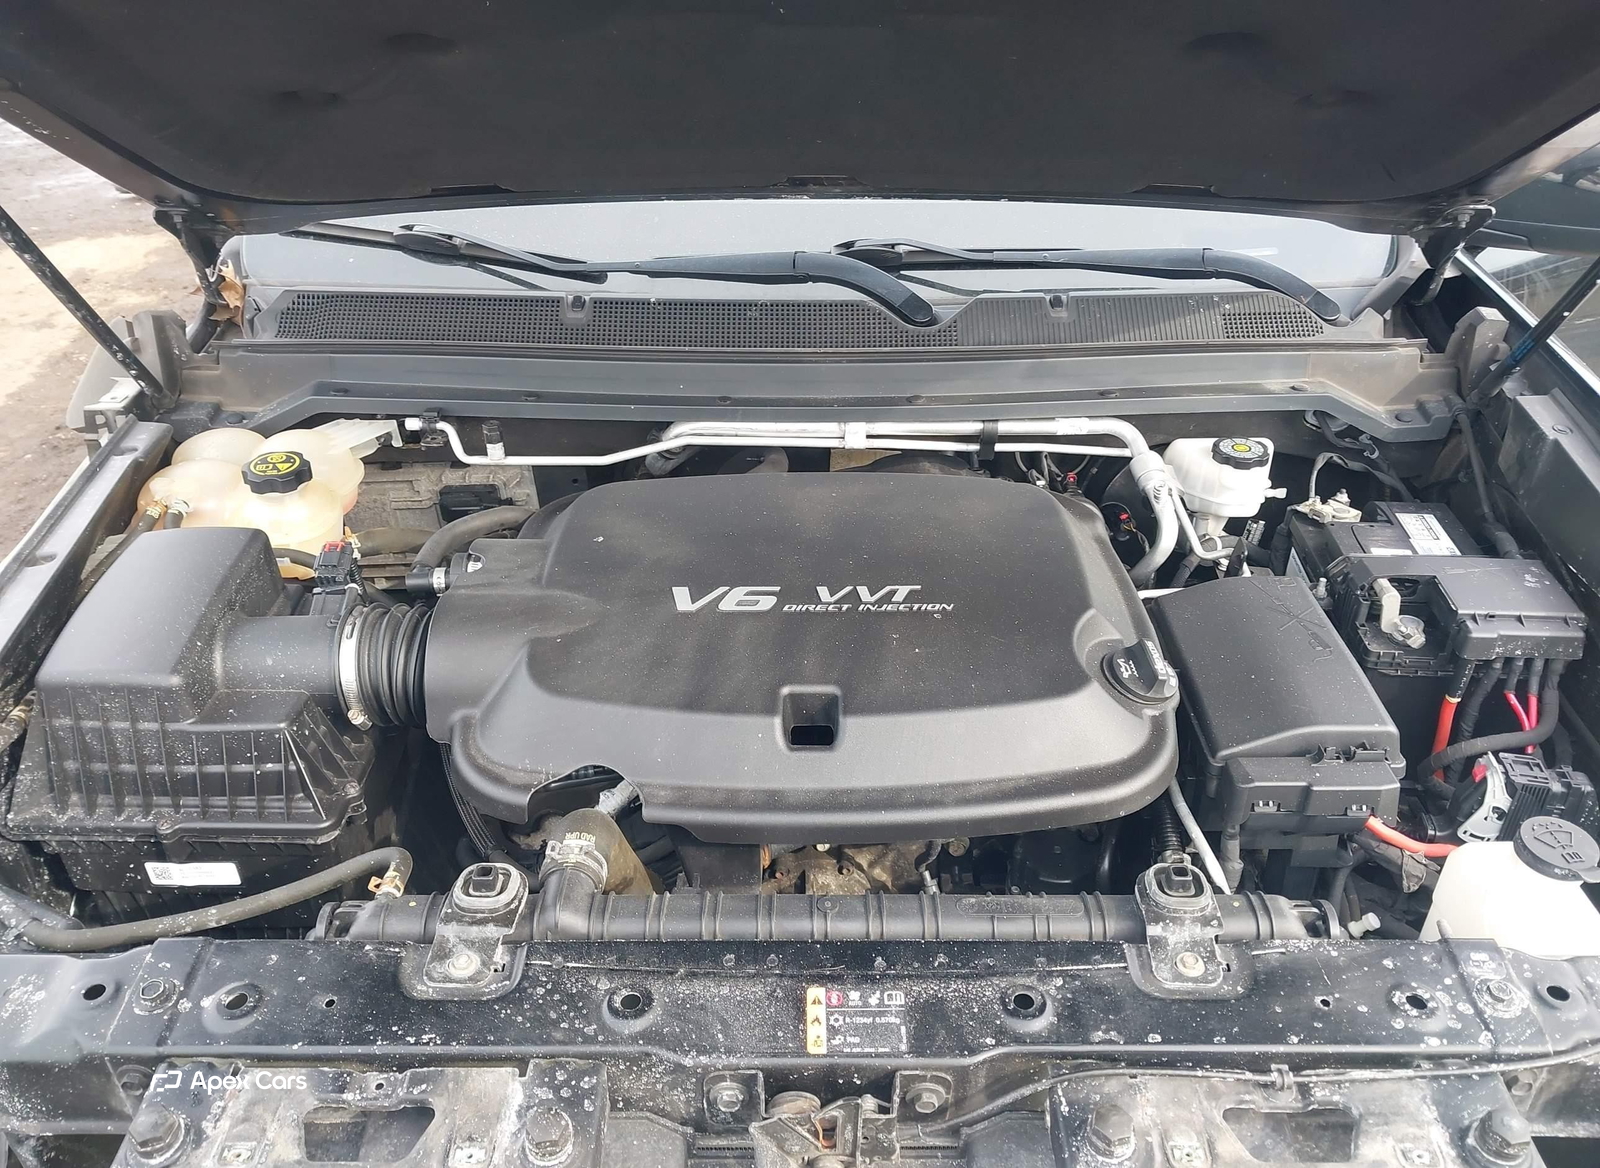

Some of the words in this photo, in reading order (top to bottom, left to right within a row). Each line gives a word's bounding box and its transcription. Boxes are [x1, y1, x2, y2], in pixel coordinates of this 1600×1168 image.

[671, 585, 781, 612] V6
[815, 585, 922, 603] VVT
[782, 603, 852, 612] DIRECT
[857, 602, 955, 612] INJECTION
[565, 831, 580, 839] UPR
[581, 832, 596, 843] RAD
